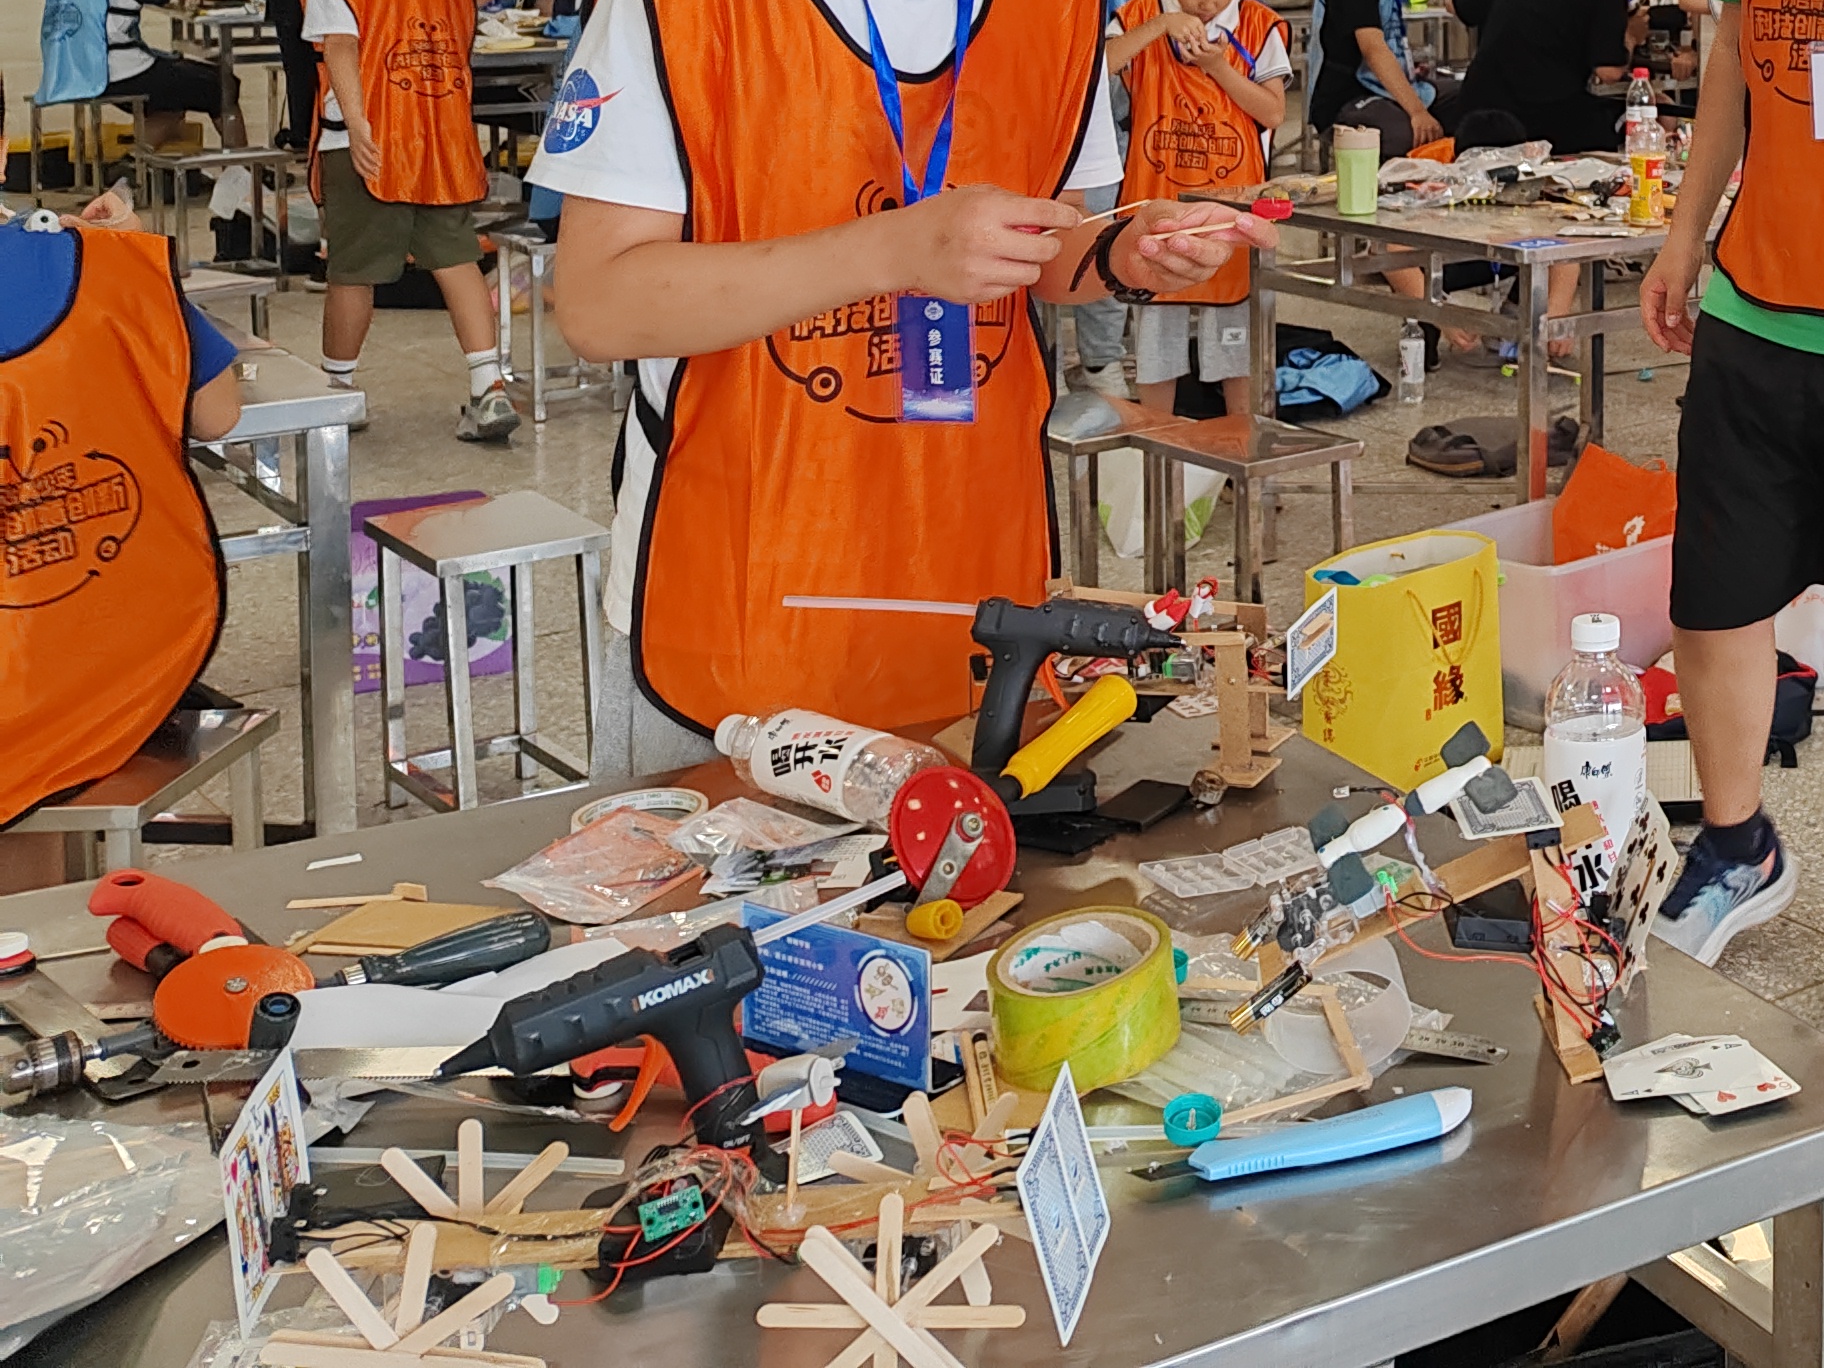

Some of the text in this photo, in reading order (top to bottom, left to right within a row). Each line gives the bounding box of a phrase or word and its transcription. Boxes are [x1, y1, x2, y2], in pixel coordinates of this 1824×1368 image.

[554, 101, 593, 129] NASA
[928, 329, 944, 385] 参赛证
[638, 968, 710, 1011] KOMAX
